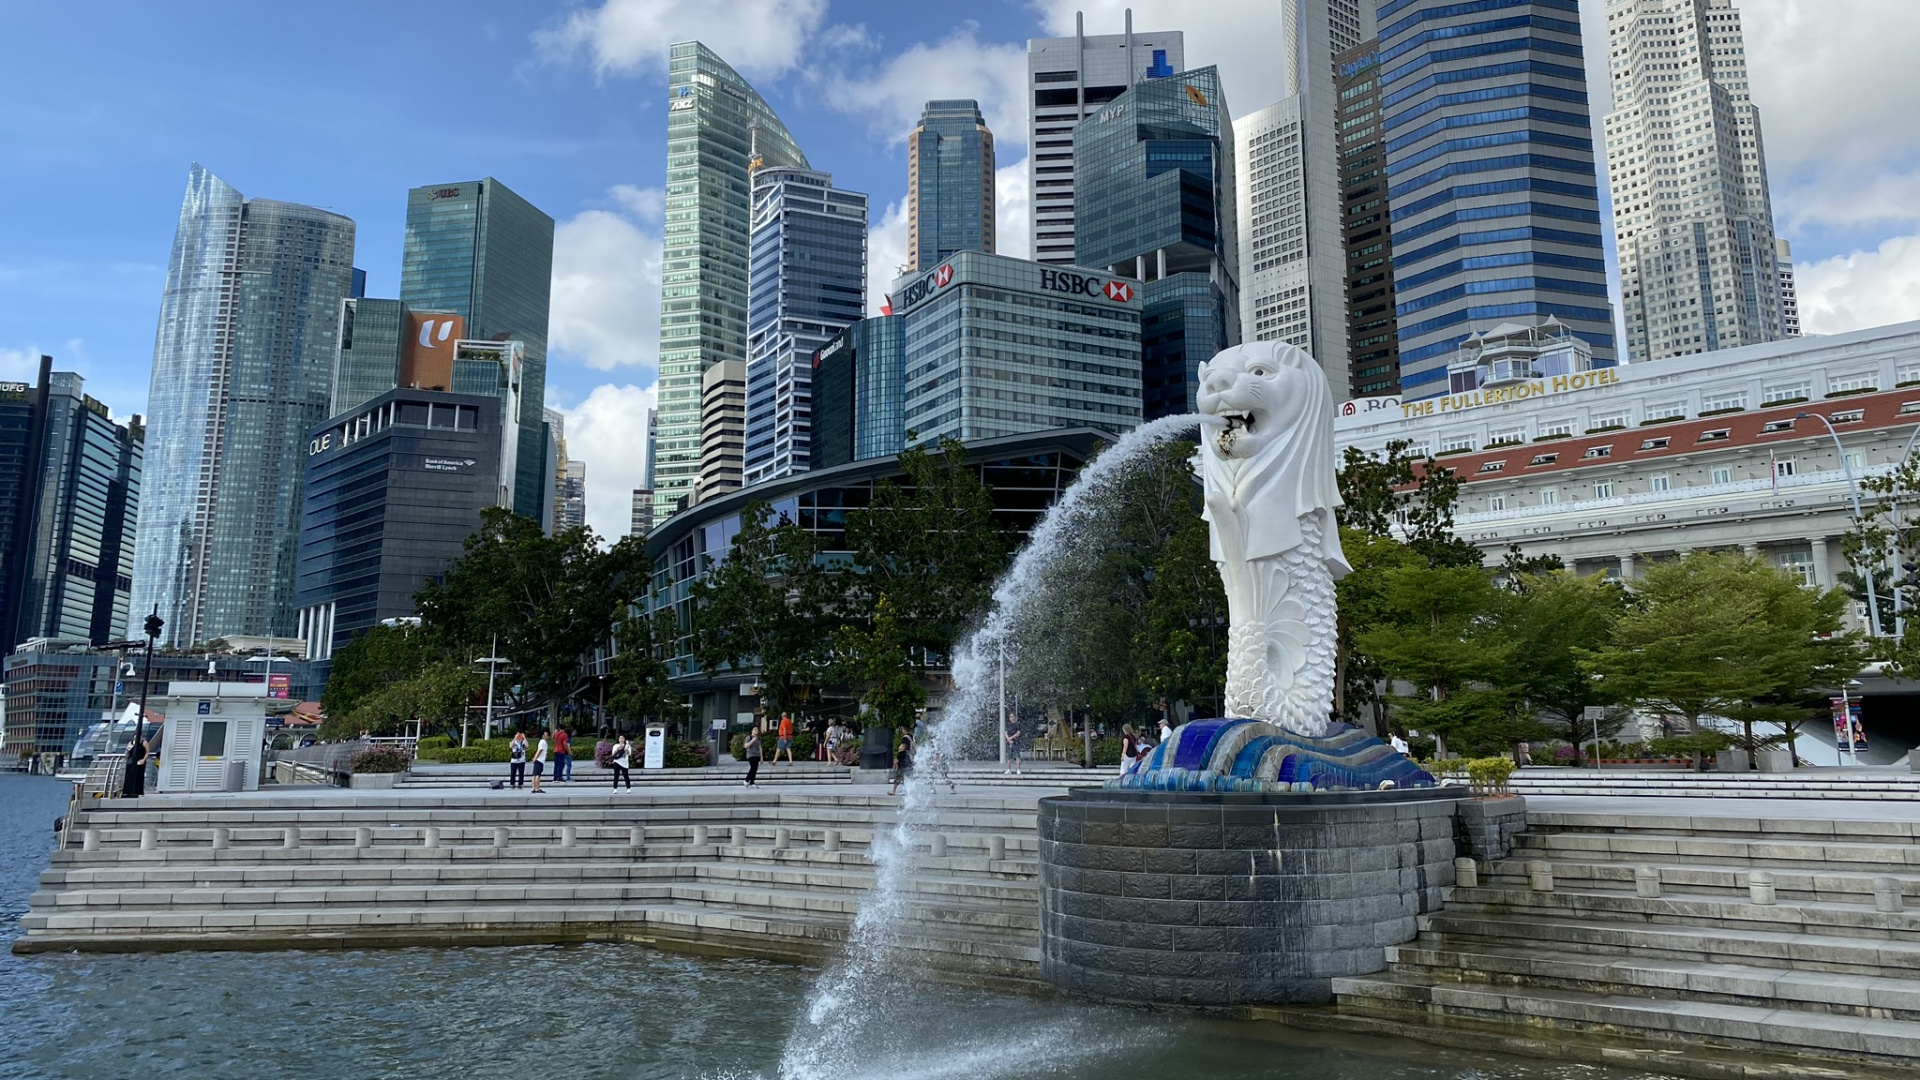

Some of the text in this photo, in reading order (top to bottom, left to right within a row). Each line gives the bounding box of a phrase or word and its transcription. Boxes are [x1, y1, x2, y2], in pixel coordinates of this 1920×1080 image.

[671, 100, 695, 111] ANZ
[1100, 104, 1125, 124] MYP
[902, 272, 936, 310] HSBC
[1040, 268, 1101, 297] HSBC
[0, 382, 25, 393] UFG
[1401, 368, 1620, 418] THE FULLERTON HOTEL
